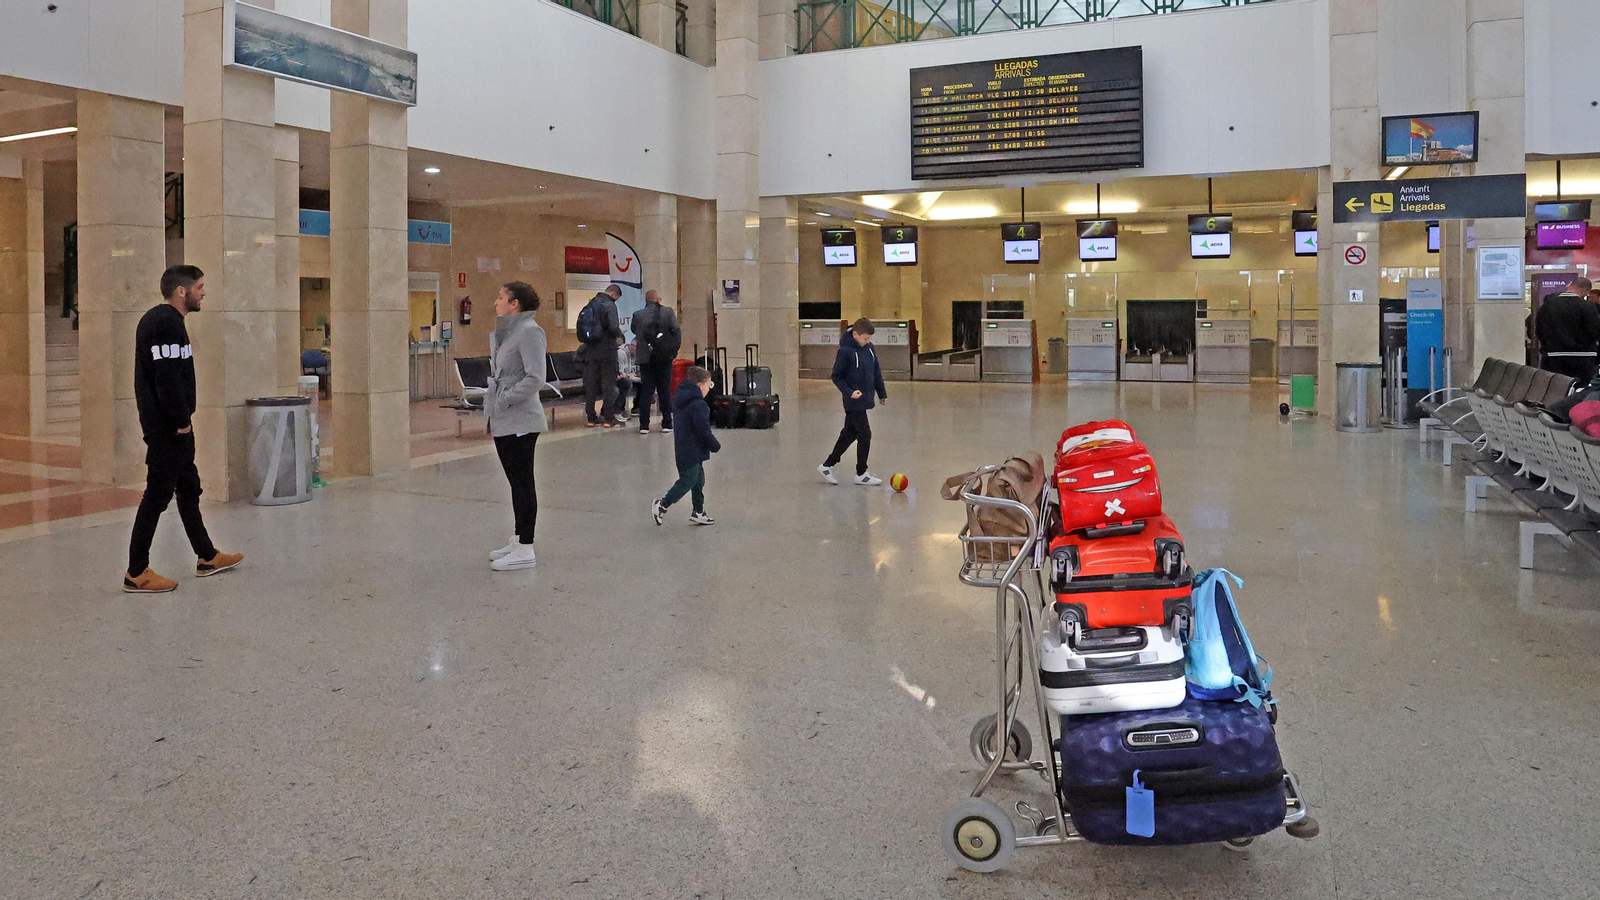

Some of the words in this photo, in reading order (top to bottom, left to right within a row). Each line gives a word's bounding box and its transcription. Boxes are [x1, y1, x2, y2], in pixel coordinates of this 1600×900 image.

[994, 60, 1038, 72] LLEGADAS
[995, 69, 1031, 79] ARRIVALS
[1048, 85, 1079, 93] DELAYED
[1048, 96, 1079, 104] DELAYED
[1024, 109, 1045, 117] 12:45
[1048, 107, 1058, 115] ON
[944, 124, 980, 133] BARCELONA
[944, 144, 969, 152] MADRID
[1400, 185, 1430, 194] Ankunft
[1400, 193, 1430, 202] Arrivals
[1401, 203, 1446, 213] Llegadas
[1557, 205, 1569, 219] 9
[1093, 221, 1102, 235] 5
[1206, 217, 1216, 231] 6
[895, 229, 904, 241] 3
[1016, 226, 1026, 238] 4
[835, 232, 843, 244] 2
